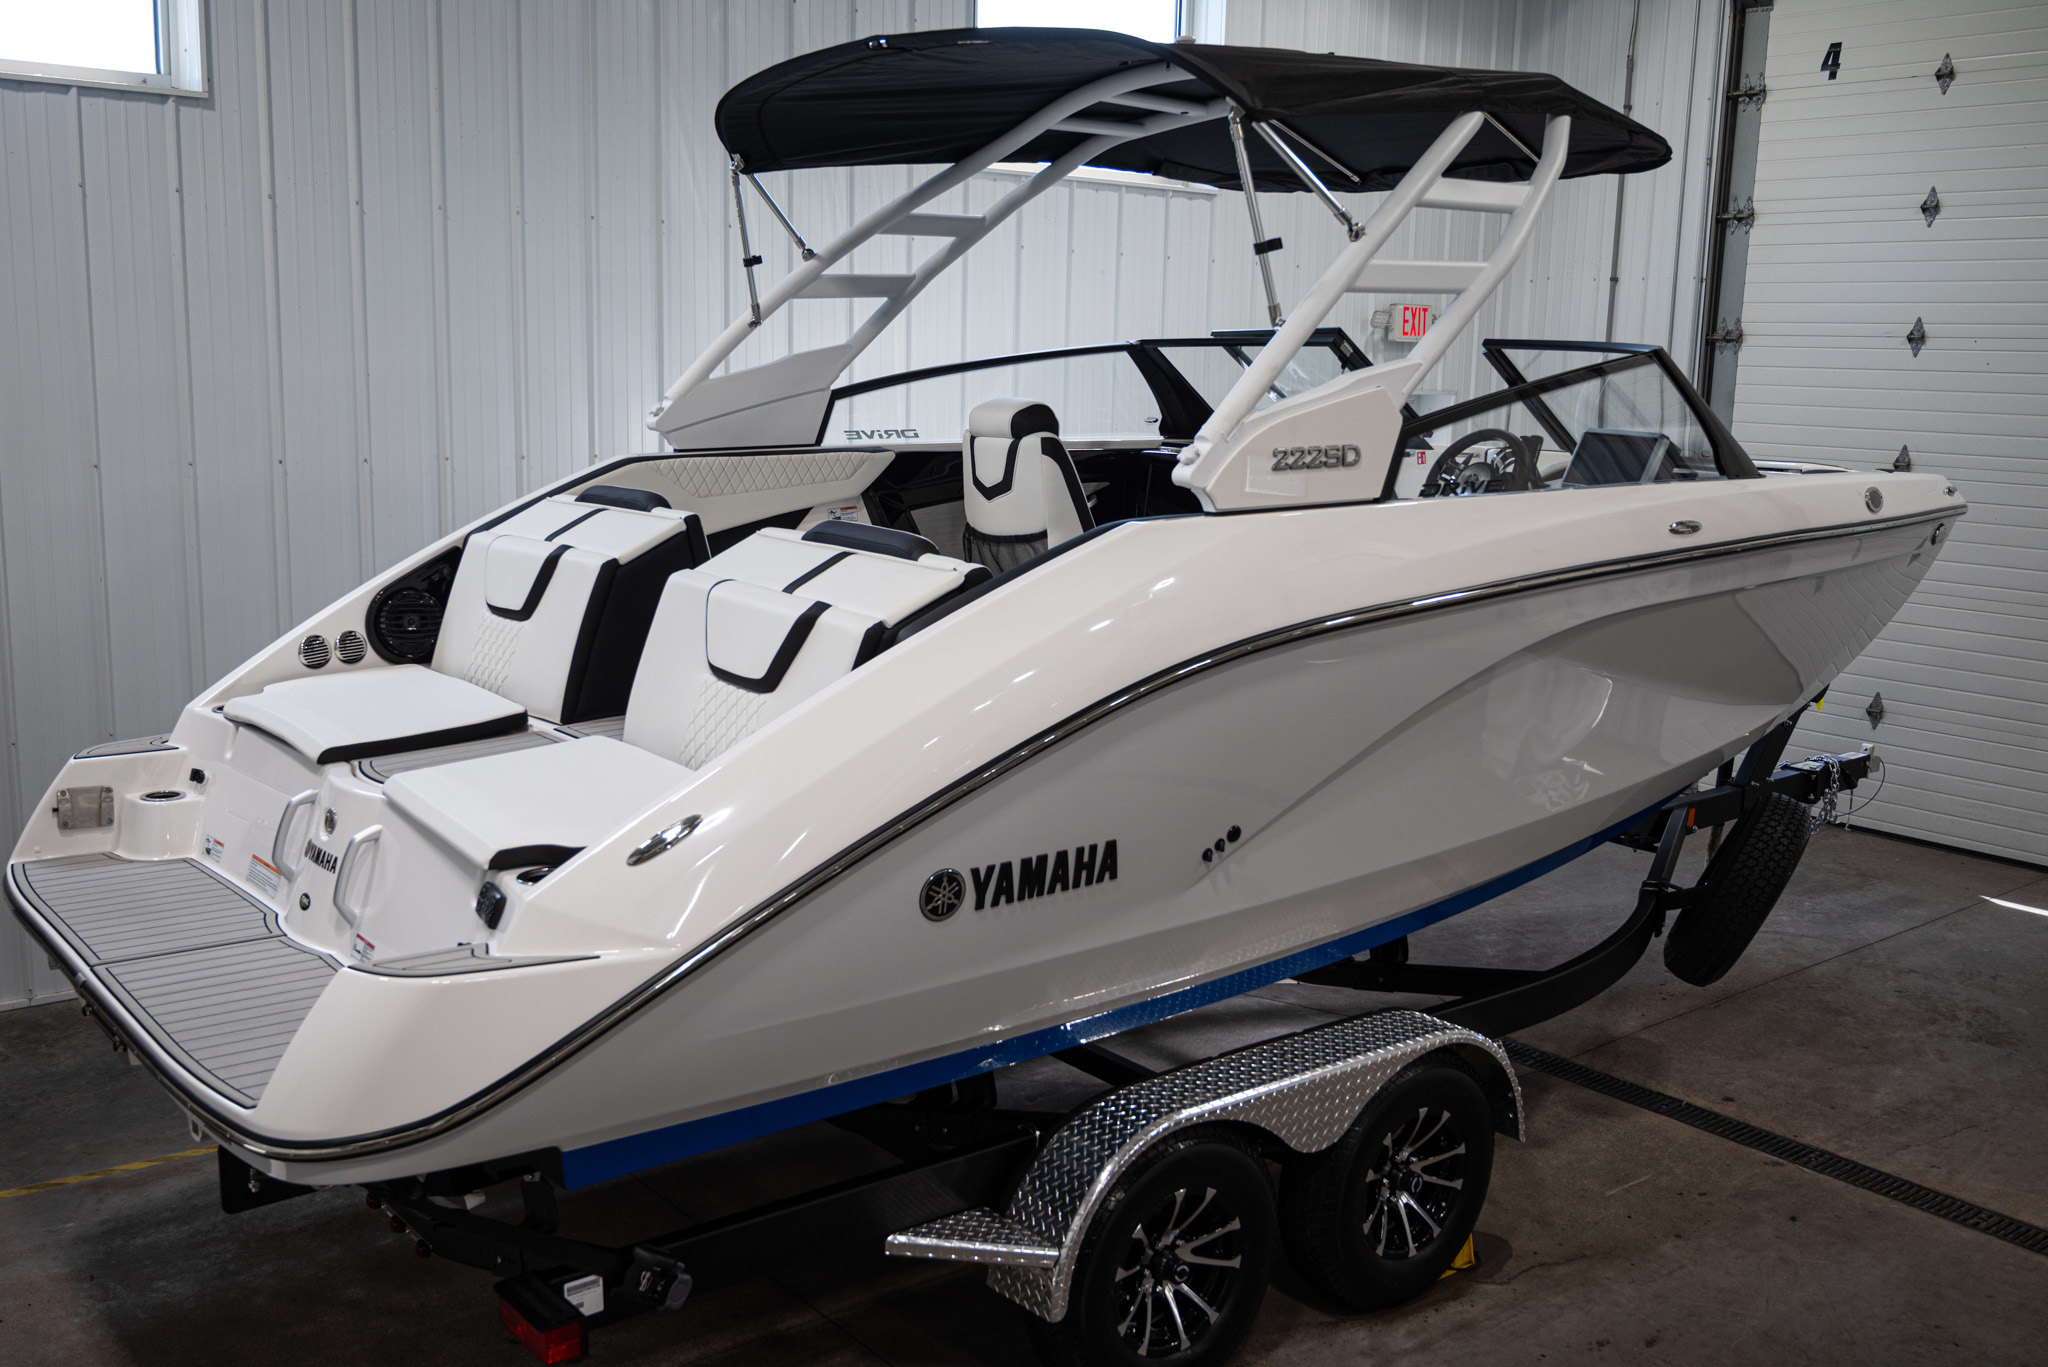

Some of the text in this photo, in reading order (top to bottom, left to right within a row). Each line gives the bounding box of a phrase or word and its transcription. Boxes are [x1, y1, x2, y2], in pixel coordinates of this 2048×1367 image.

[1820, 41, 1843, 81] 4
[1402, 306, 1429, 337] EXIT
[1271, 444, 1362, 472] 222SD
[308, 842, 338, 874] YAMAHA
[970, 838, 1119, 911] YAMAHA
